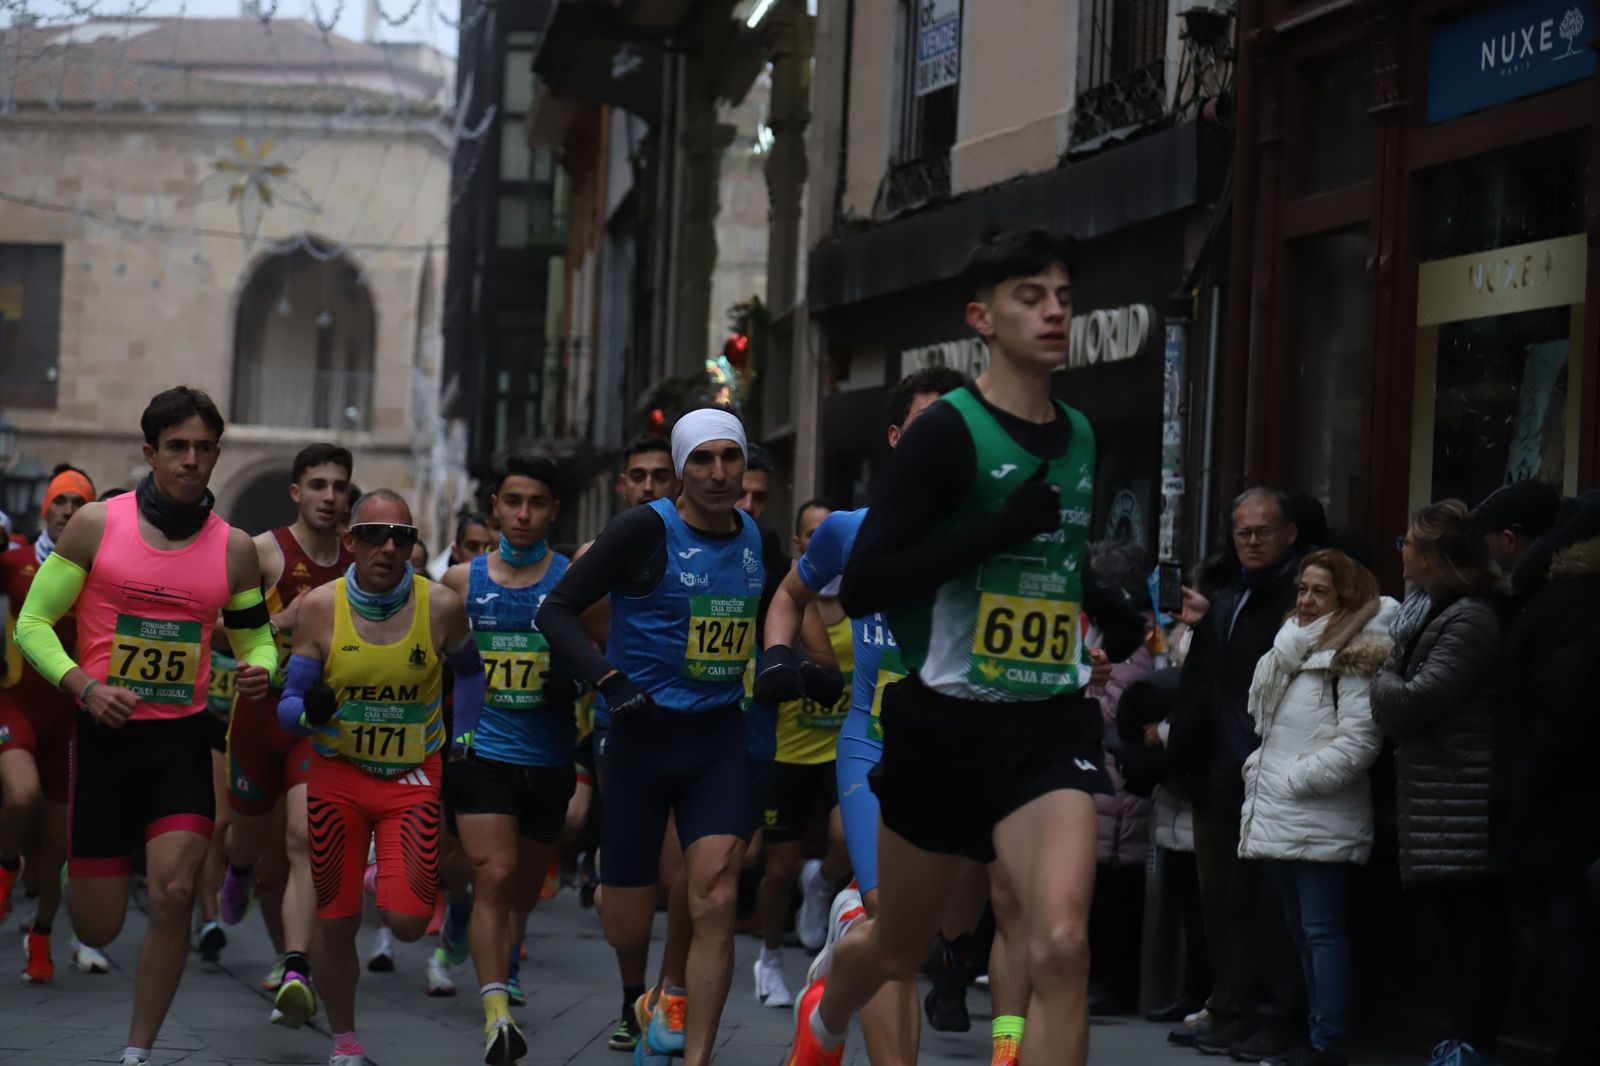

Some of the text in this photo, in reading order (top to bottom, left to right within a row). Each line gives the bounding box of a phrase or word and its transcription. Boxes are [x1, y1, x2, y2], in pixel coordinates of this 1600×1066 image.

[1481, 18, 1554, 72] NUXE
[1469, 255, 1533, 294] NUXE
[695, 620, 749, 654] 1247
[983, 607, 1071, 661] 695
[118, 644, 187, 682] 735
[483, 659, 534, 689] 717
[707, 665, 726, 676] CAJA
[1005, 668, 1038, 683] CAJA
[131, 686, 188, 698] CAJA RURAL
[344, 685, 419, 702] TEAM
[351, 725, 406, 757] 1171
